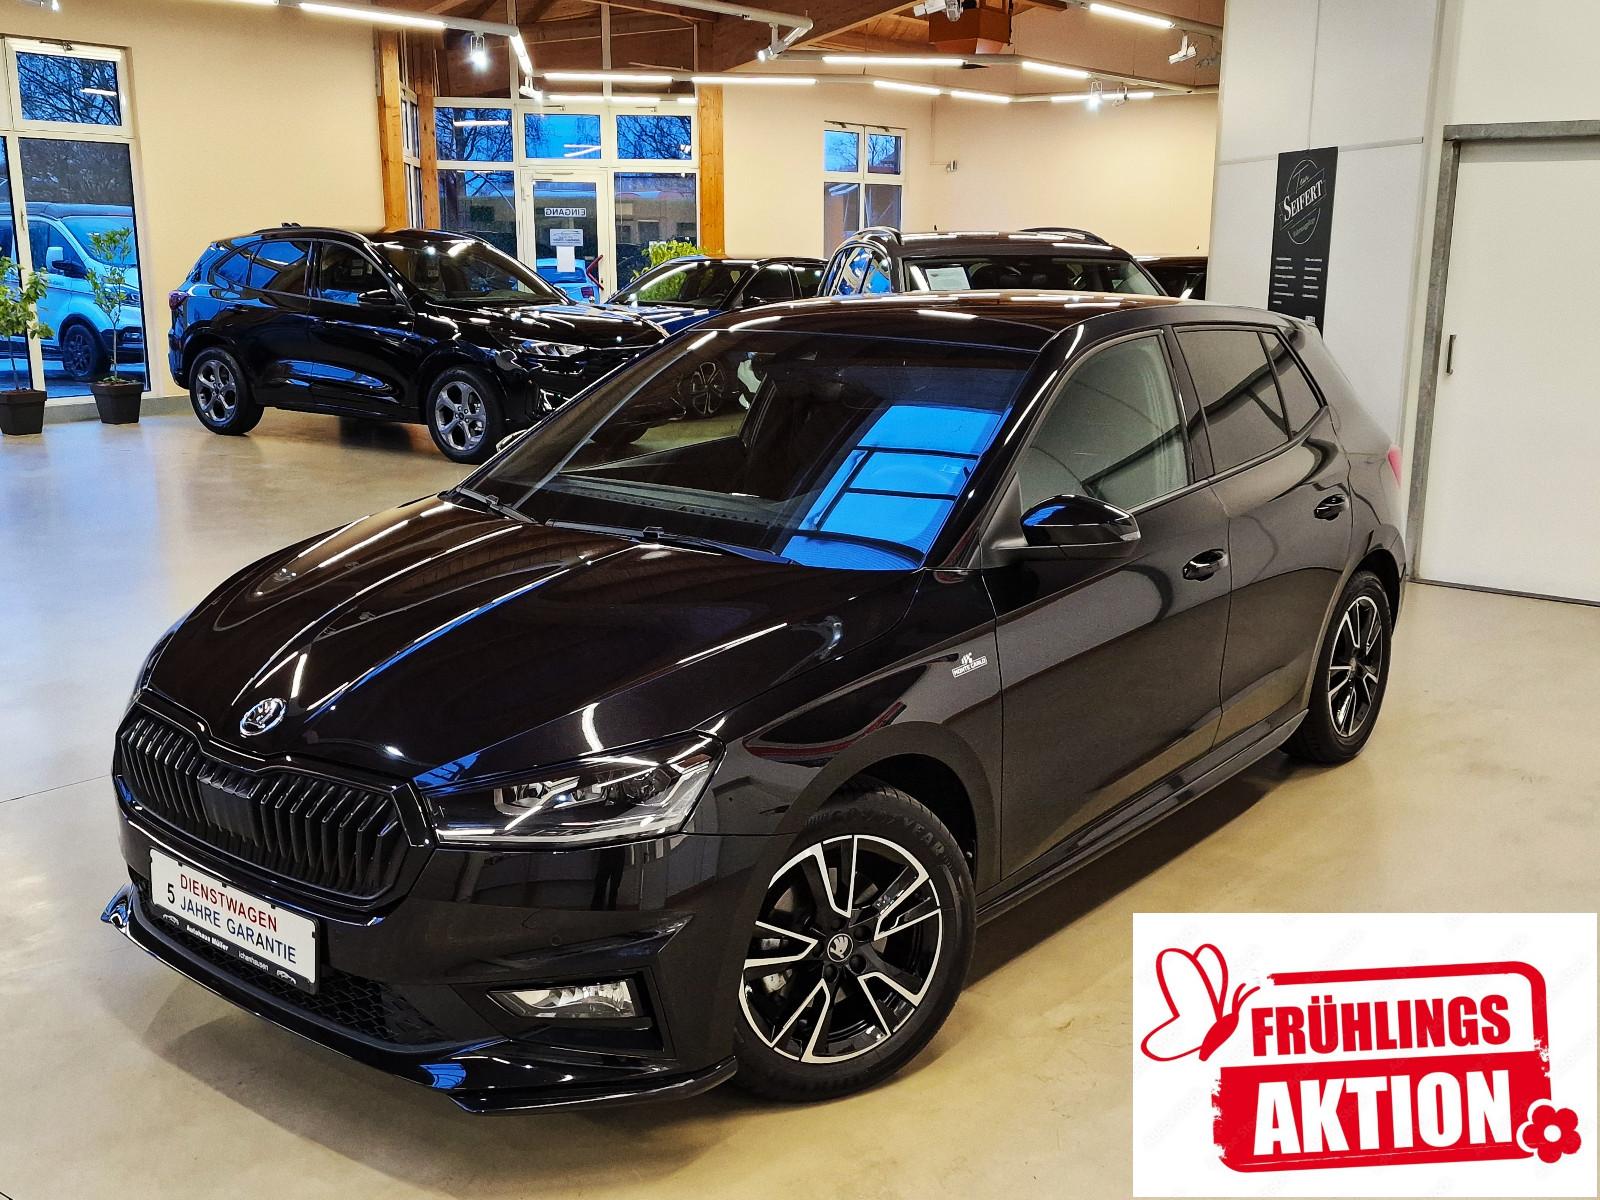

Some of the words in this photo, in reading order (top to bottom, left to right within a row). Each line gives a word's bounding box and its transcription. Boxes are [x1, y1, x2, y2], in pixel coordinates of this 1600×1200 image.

[953, 664, 971, 676] MONTE
[167, 882, 176, 904] 5
[180, 896, 221, 928] JAHRE
[226, 918, 297, 964] GARANTIE
[180, 873, 277, 932] DIENSTWAGEN
[186, 924, 211, 943] Autohaus
[211, 937, 229, 951] Müller
